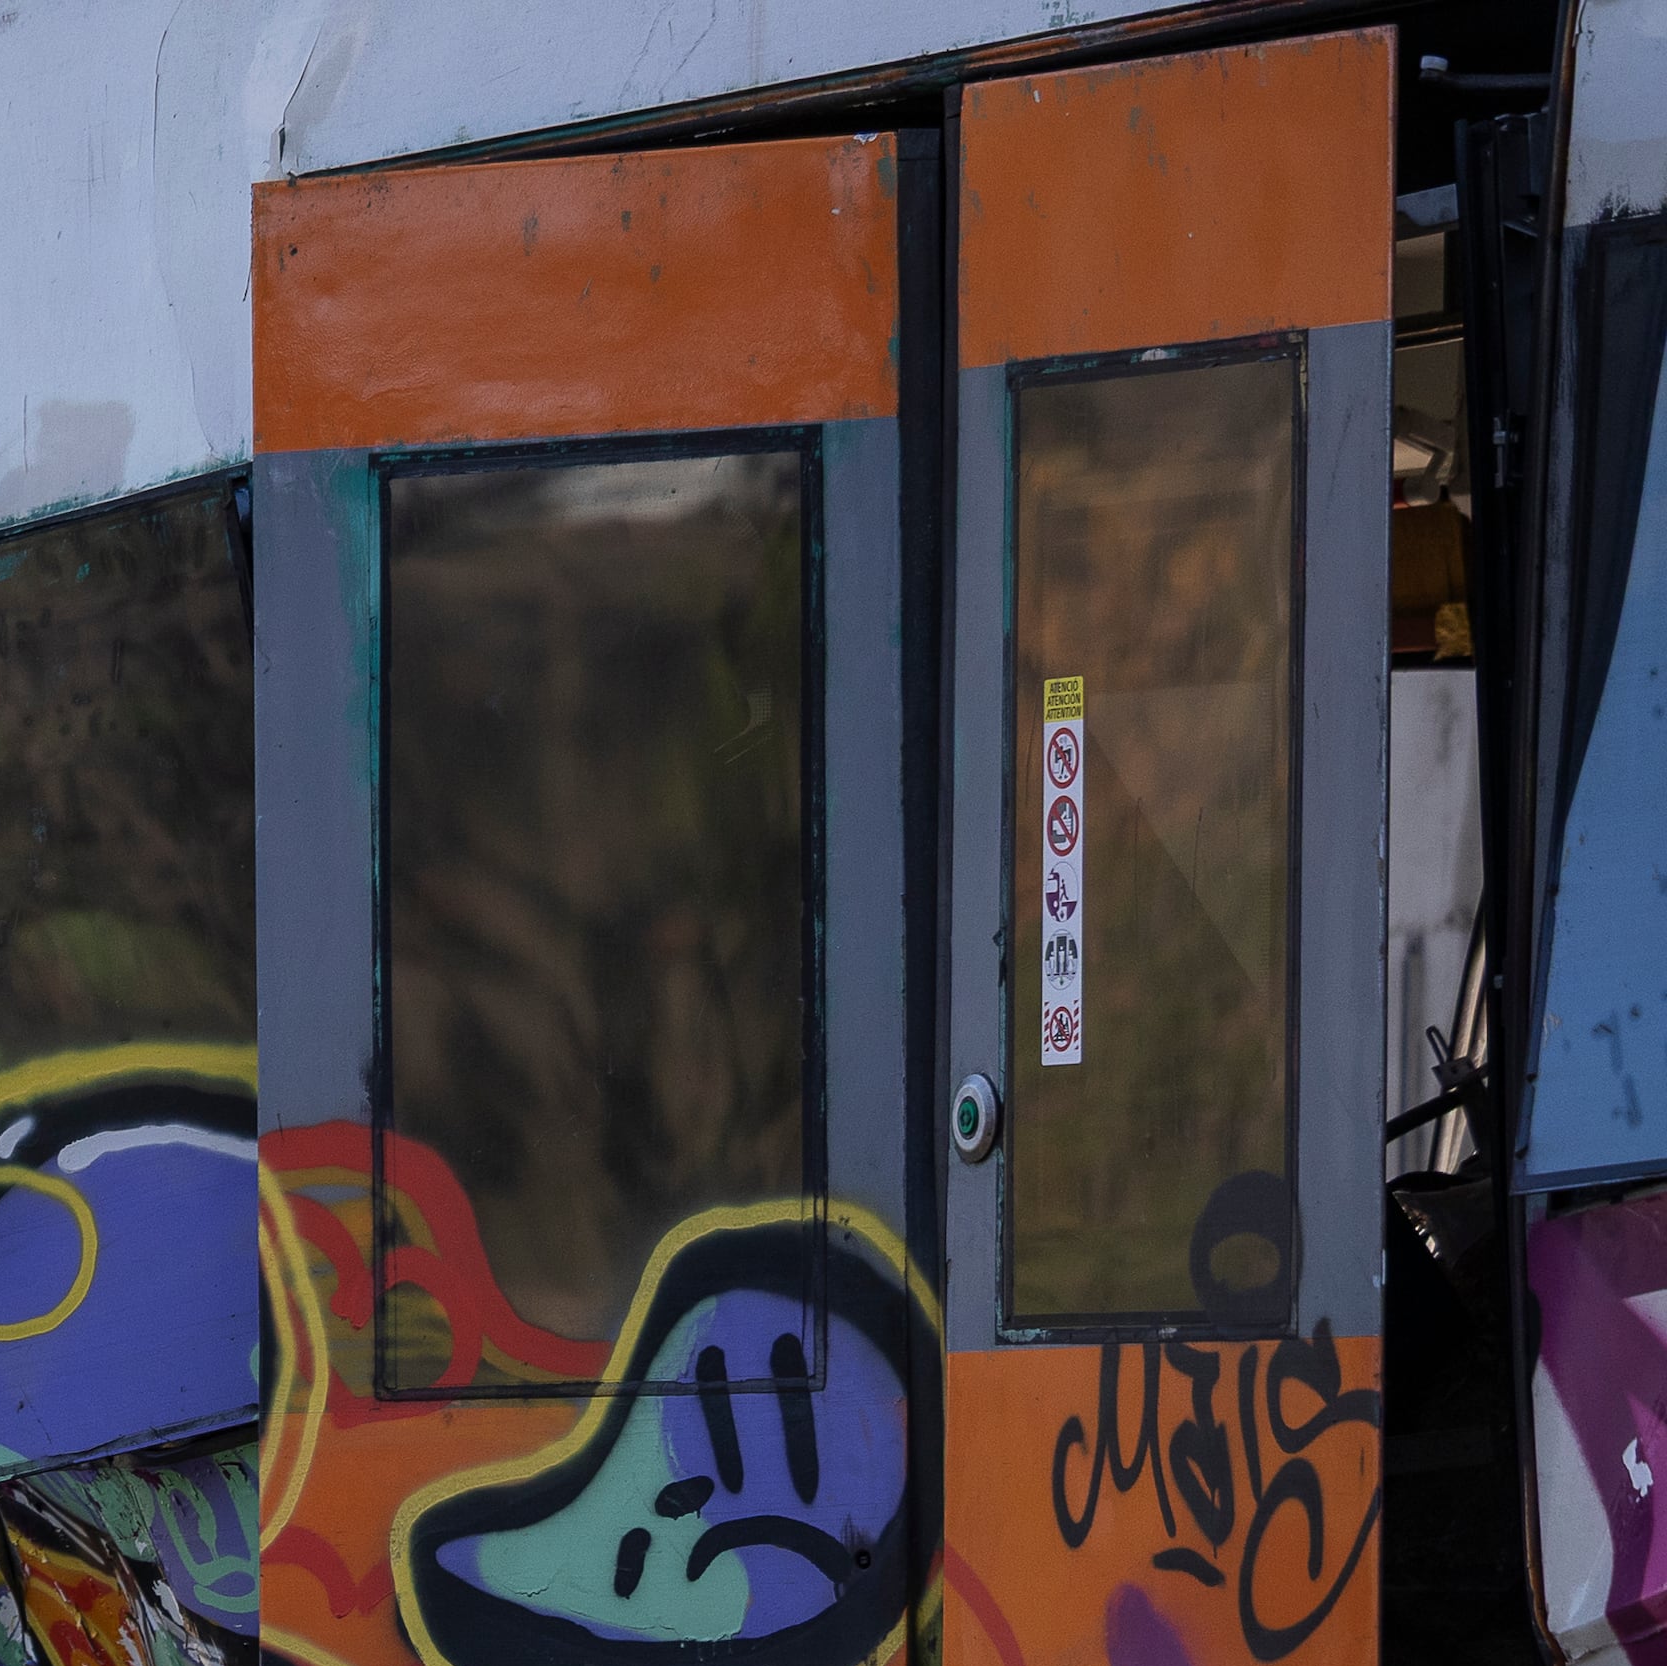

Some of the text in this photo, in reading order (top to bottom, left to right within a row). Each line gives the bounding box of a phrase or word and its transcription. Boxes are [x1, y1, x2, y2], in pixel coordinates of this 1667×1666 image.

[1050, 678, 1078, 693] ATENCIÓ
[1047, 692, 1081, 706] ATENCIÓN
[1046, 706, 1081, 719] ATTENTION
